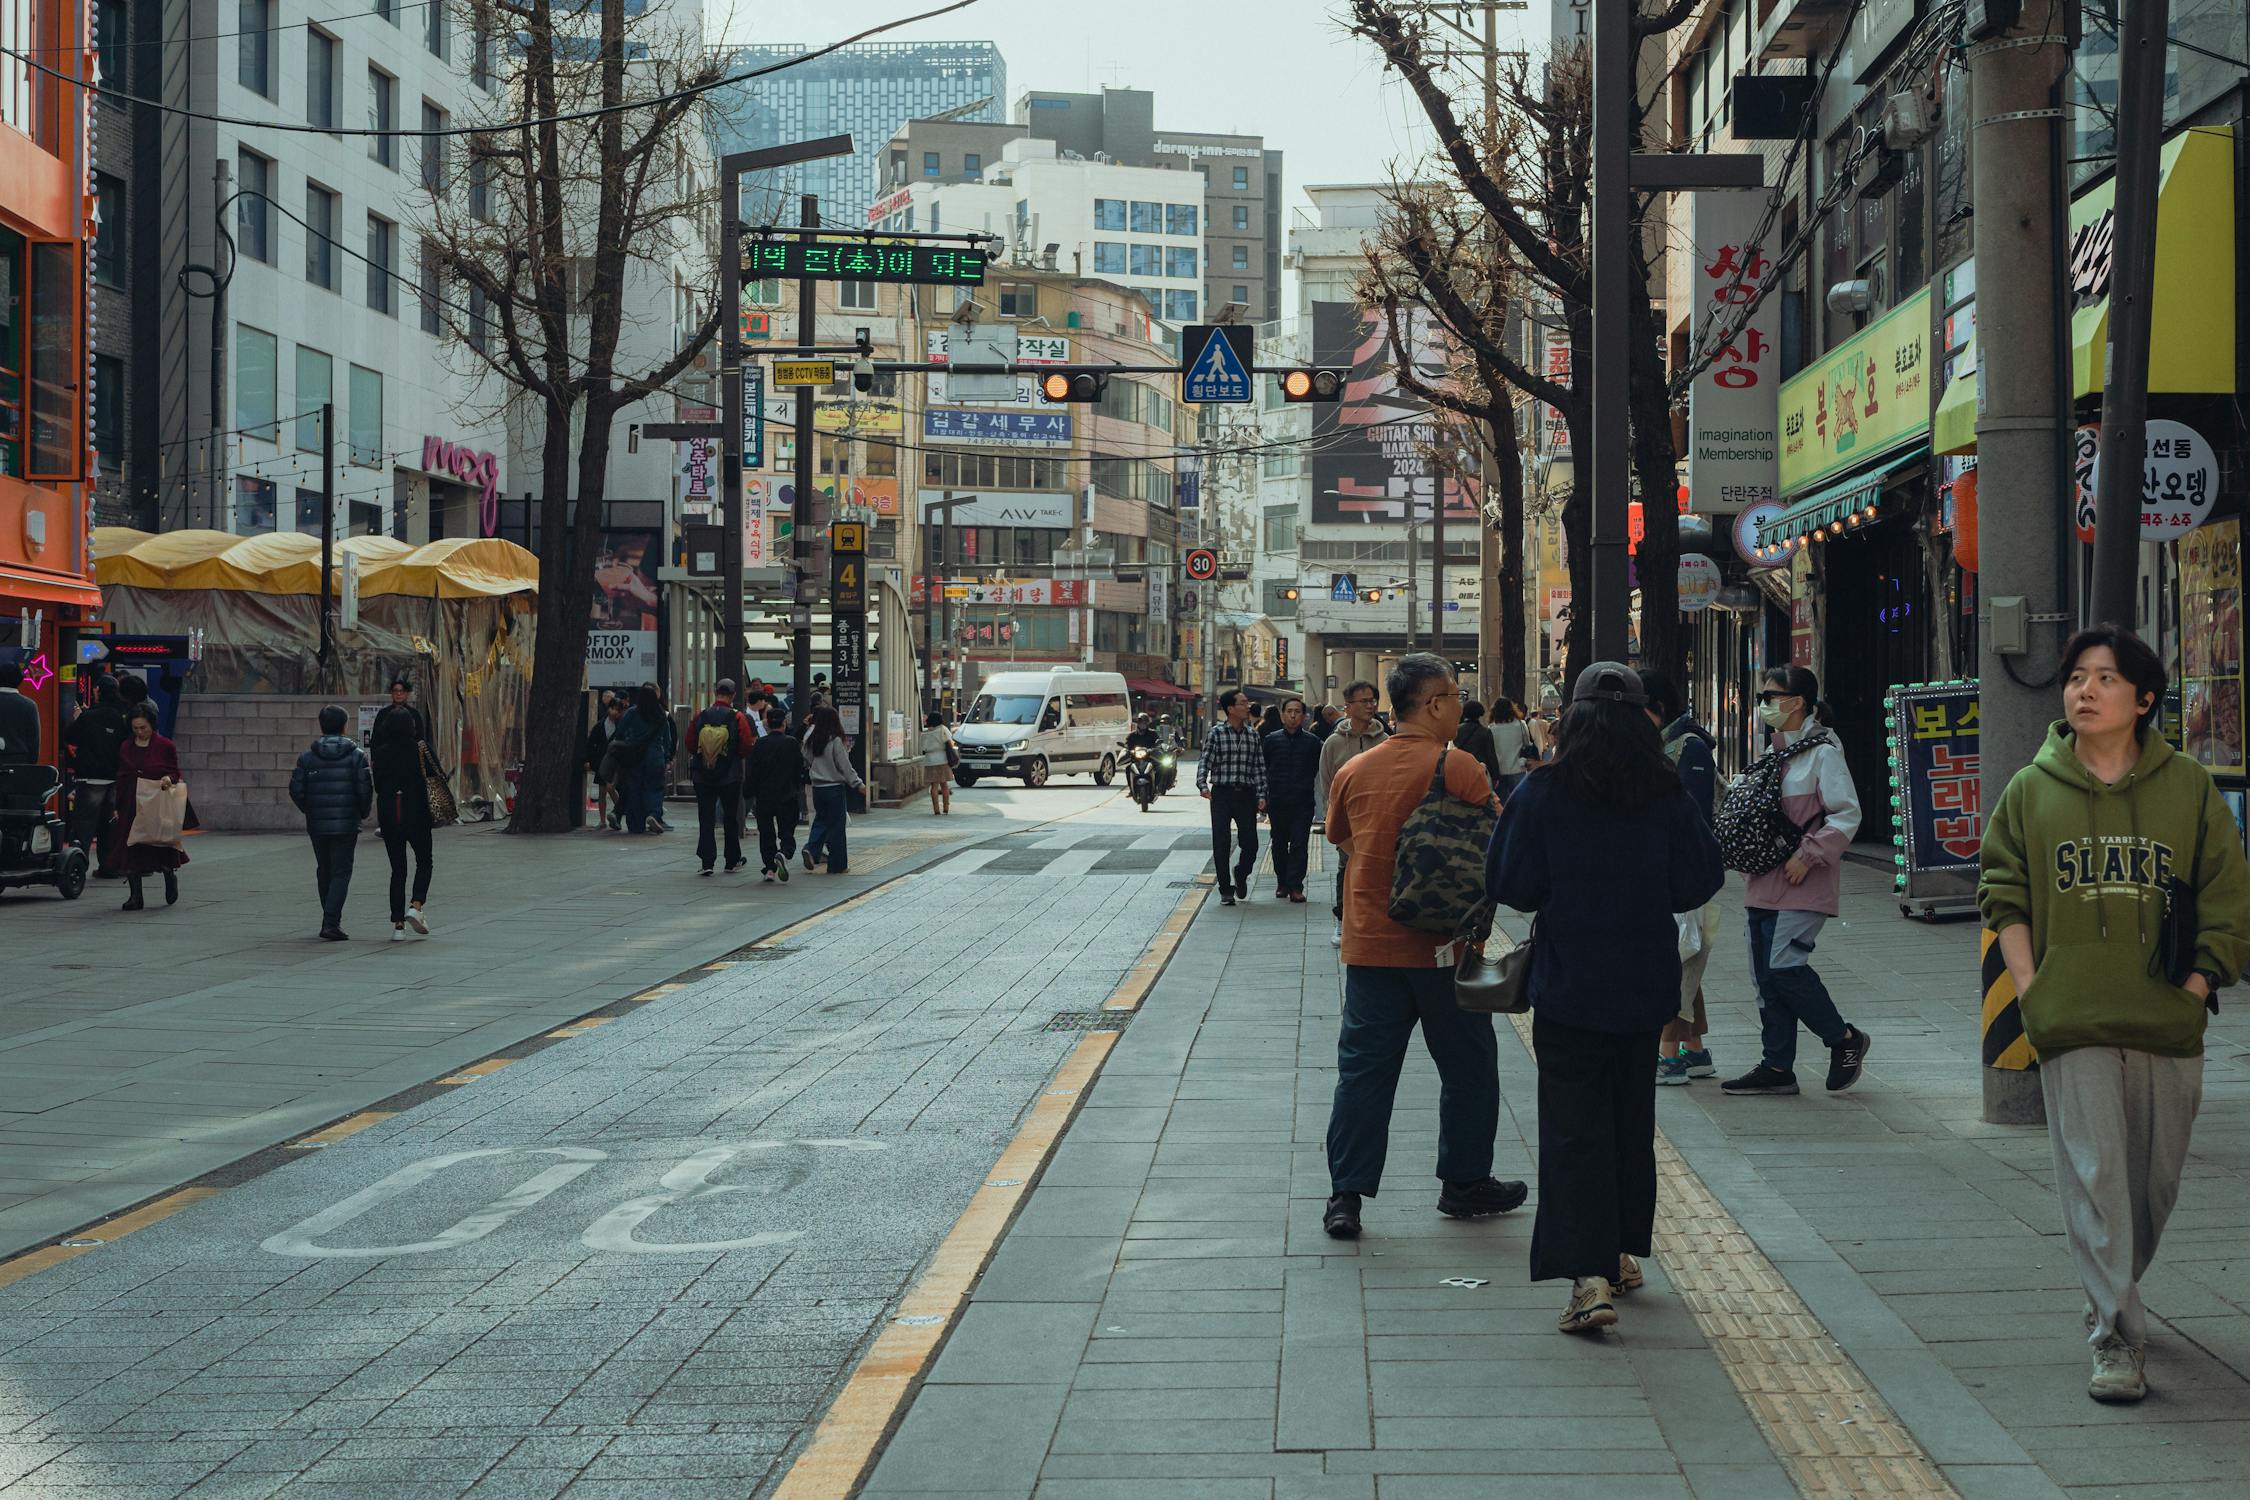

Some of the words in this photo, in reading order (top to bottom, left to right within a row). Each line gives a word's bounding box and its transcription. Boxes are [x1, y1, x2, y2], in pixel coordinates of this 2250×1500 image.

[1704, 243, 1770, 389] 상상
[796, 367, 813, 379] CCTV
[1191, 385, 1244, 398] 횡단보도
[1366, 425, 1410, 442] GUITAR
[1699, 428, 1773, 445] imagination
[1699, 448, 1773, 463] Membership
[690, 437, 709, 494] 사주타로
[1393, 459, 1424, 475] 2024
[1721, 486, 1773, 502] 단란주점
[871, 496, 891, 509] 3층
[1193, 558, 1210, 571] 30
[839, 564, 857, 588] 4
[837, 619, 850, 678] 종로3가
[2055, 840, 2173, 893] SLAKE
